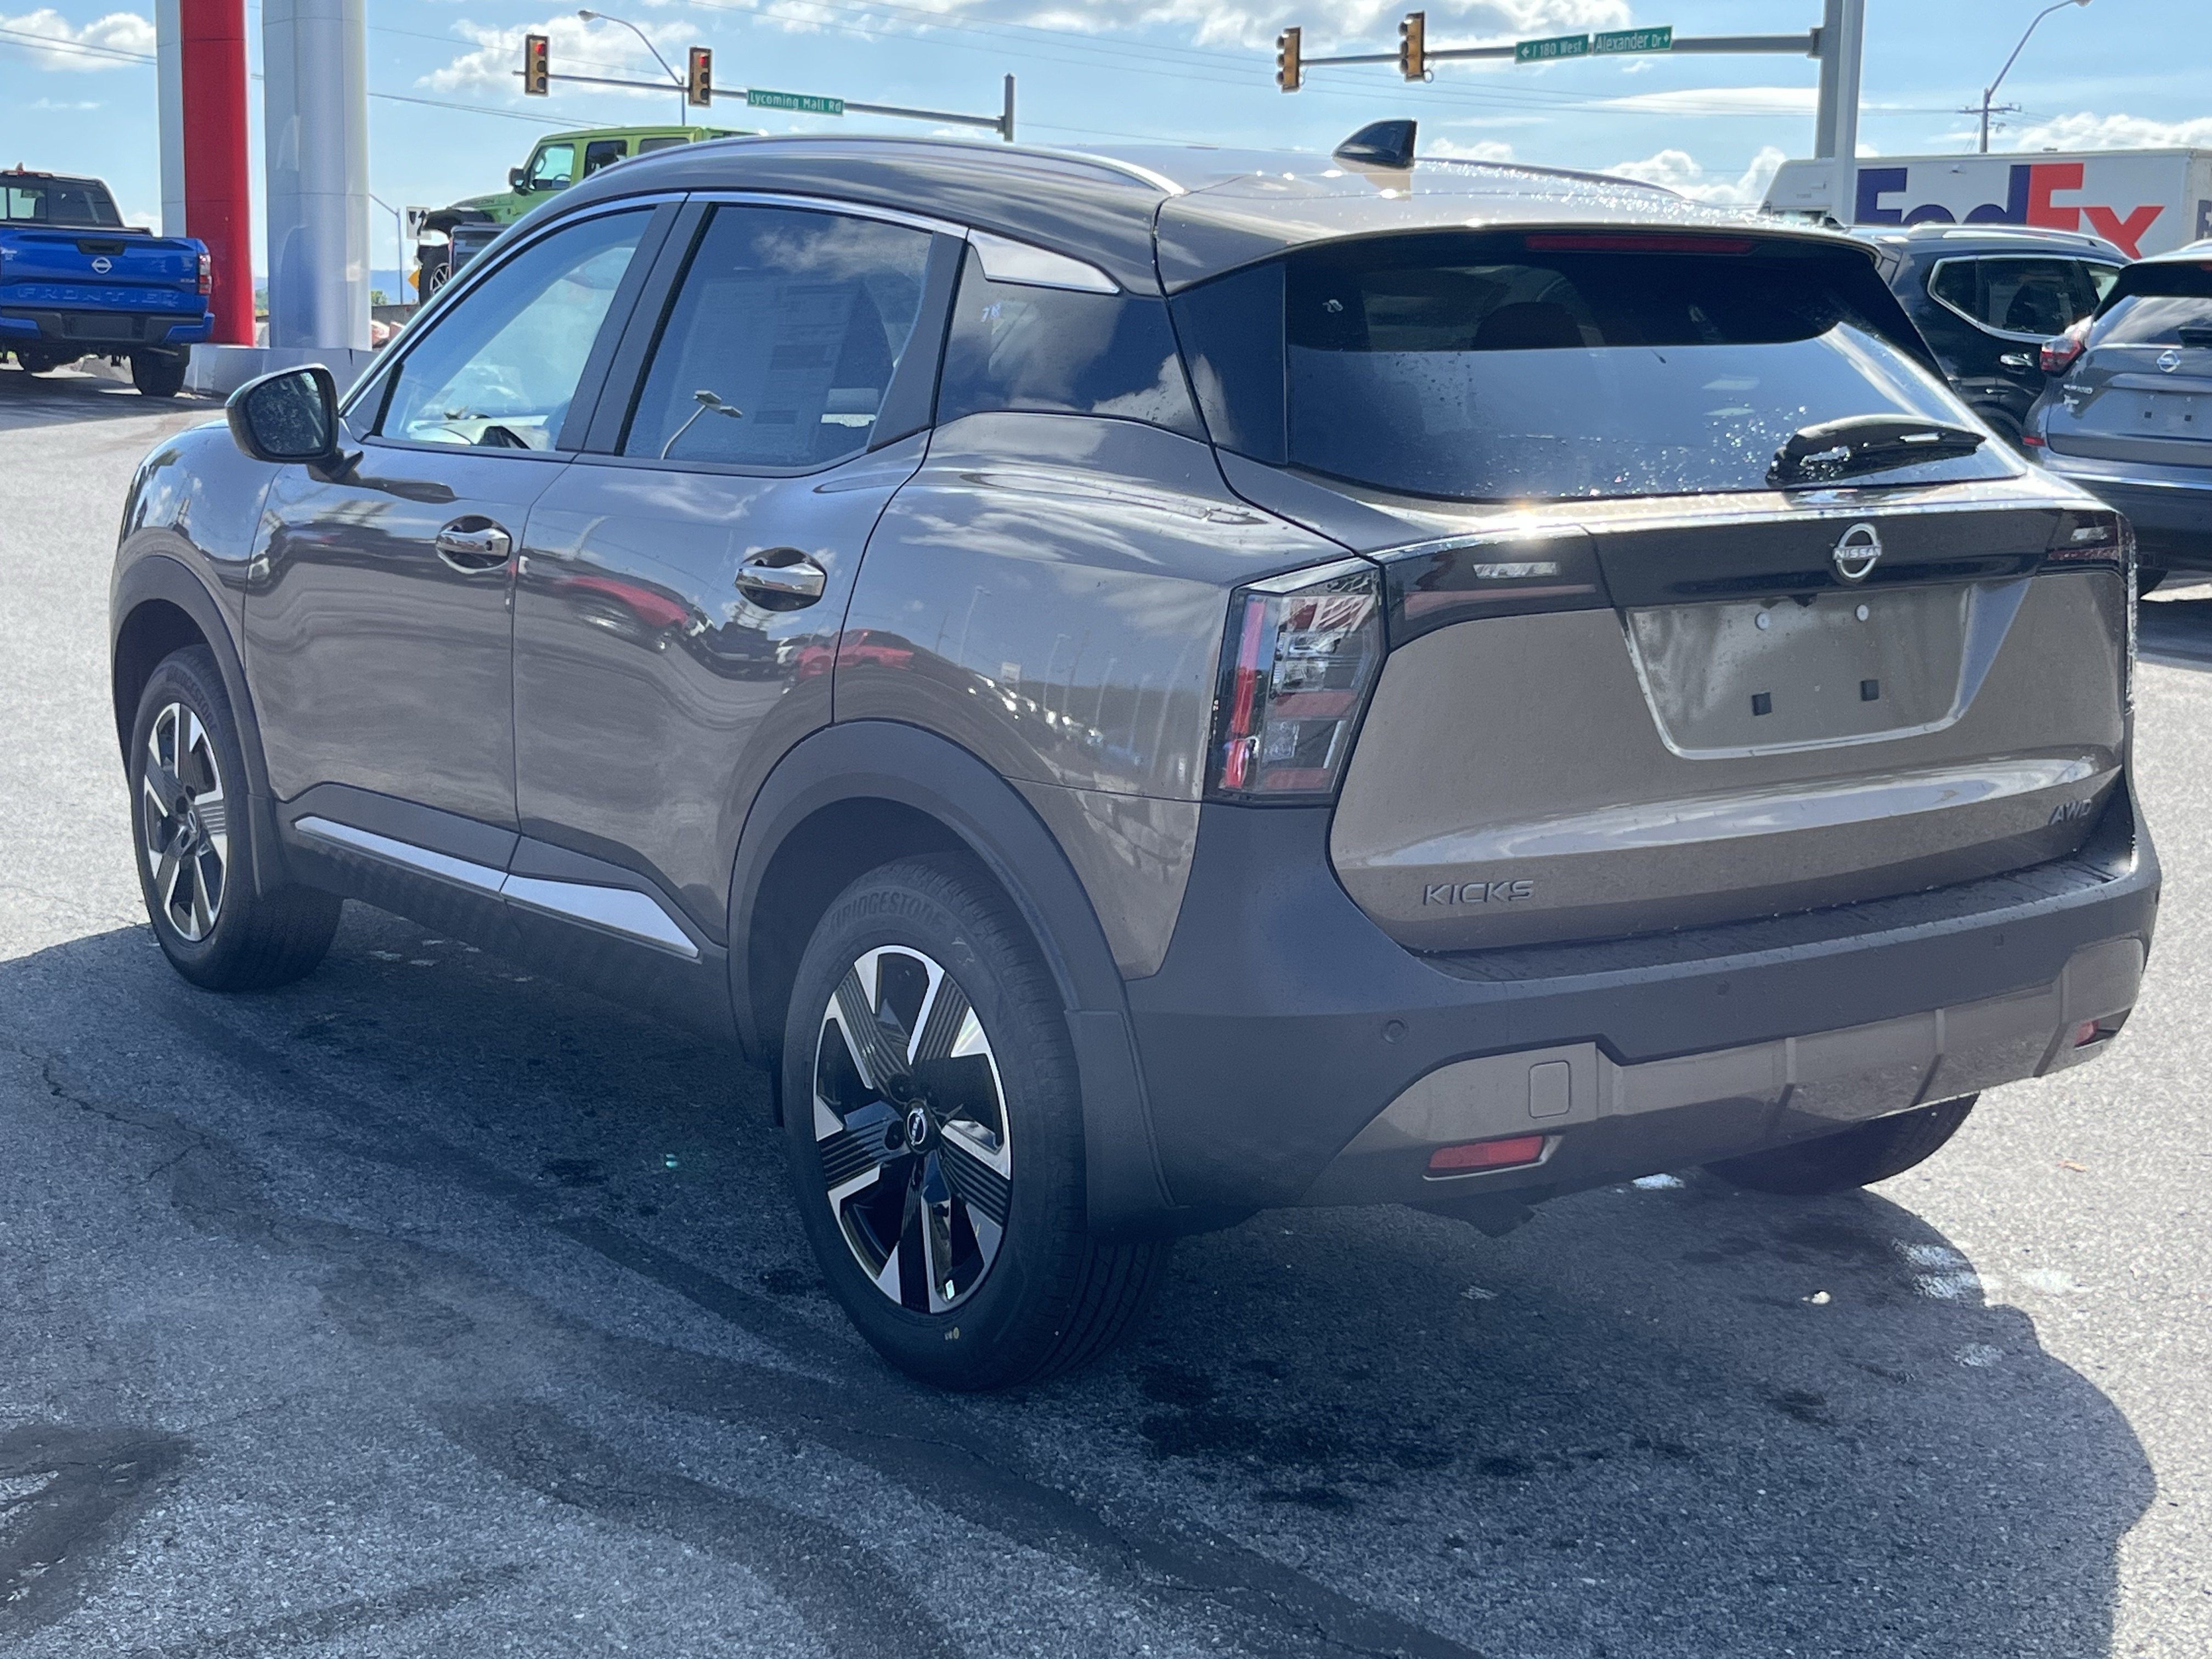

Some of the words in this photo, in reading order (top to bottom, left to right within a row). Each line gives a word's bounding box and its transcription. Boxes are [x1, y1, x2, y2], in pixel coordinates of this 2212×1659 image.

[1540, 43, 1556, 56] 180
[1560, 41, 1582, 54] West
[1595, 32, 1649, 52] Alexander
[1651, 36, 1662, 48] Dr
[750, 92, 799, 110] Lycoming
[803, 98, 825, 111] Mall
[828, 100, 842, 112] Rd
[18, 287, 179, 307] FRONTIER
[1833, 547, 1882, 559] NISSAN
[2047, 798, 2091, 825] AWD
[1423, 879, 1534, 905] KICKS
[828, 890, 949, 931] BRIDGESTONE
